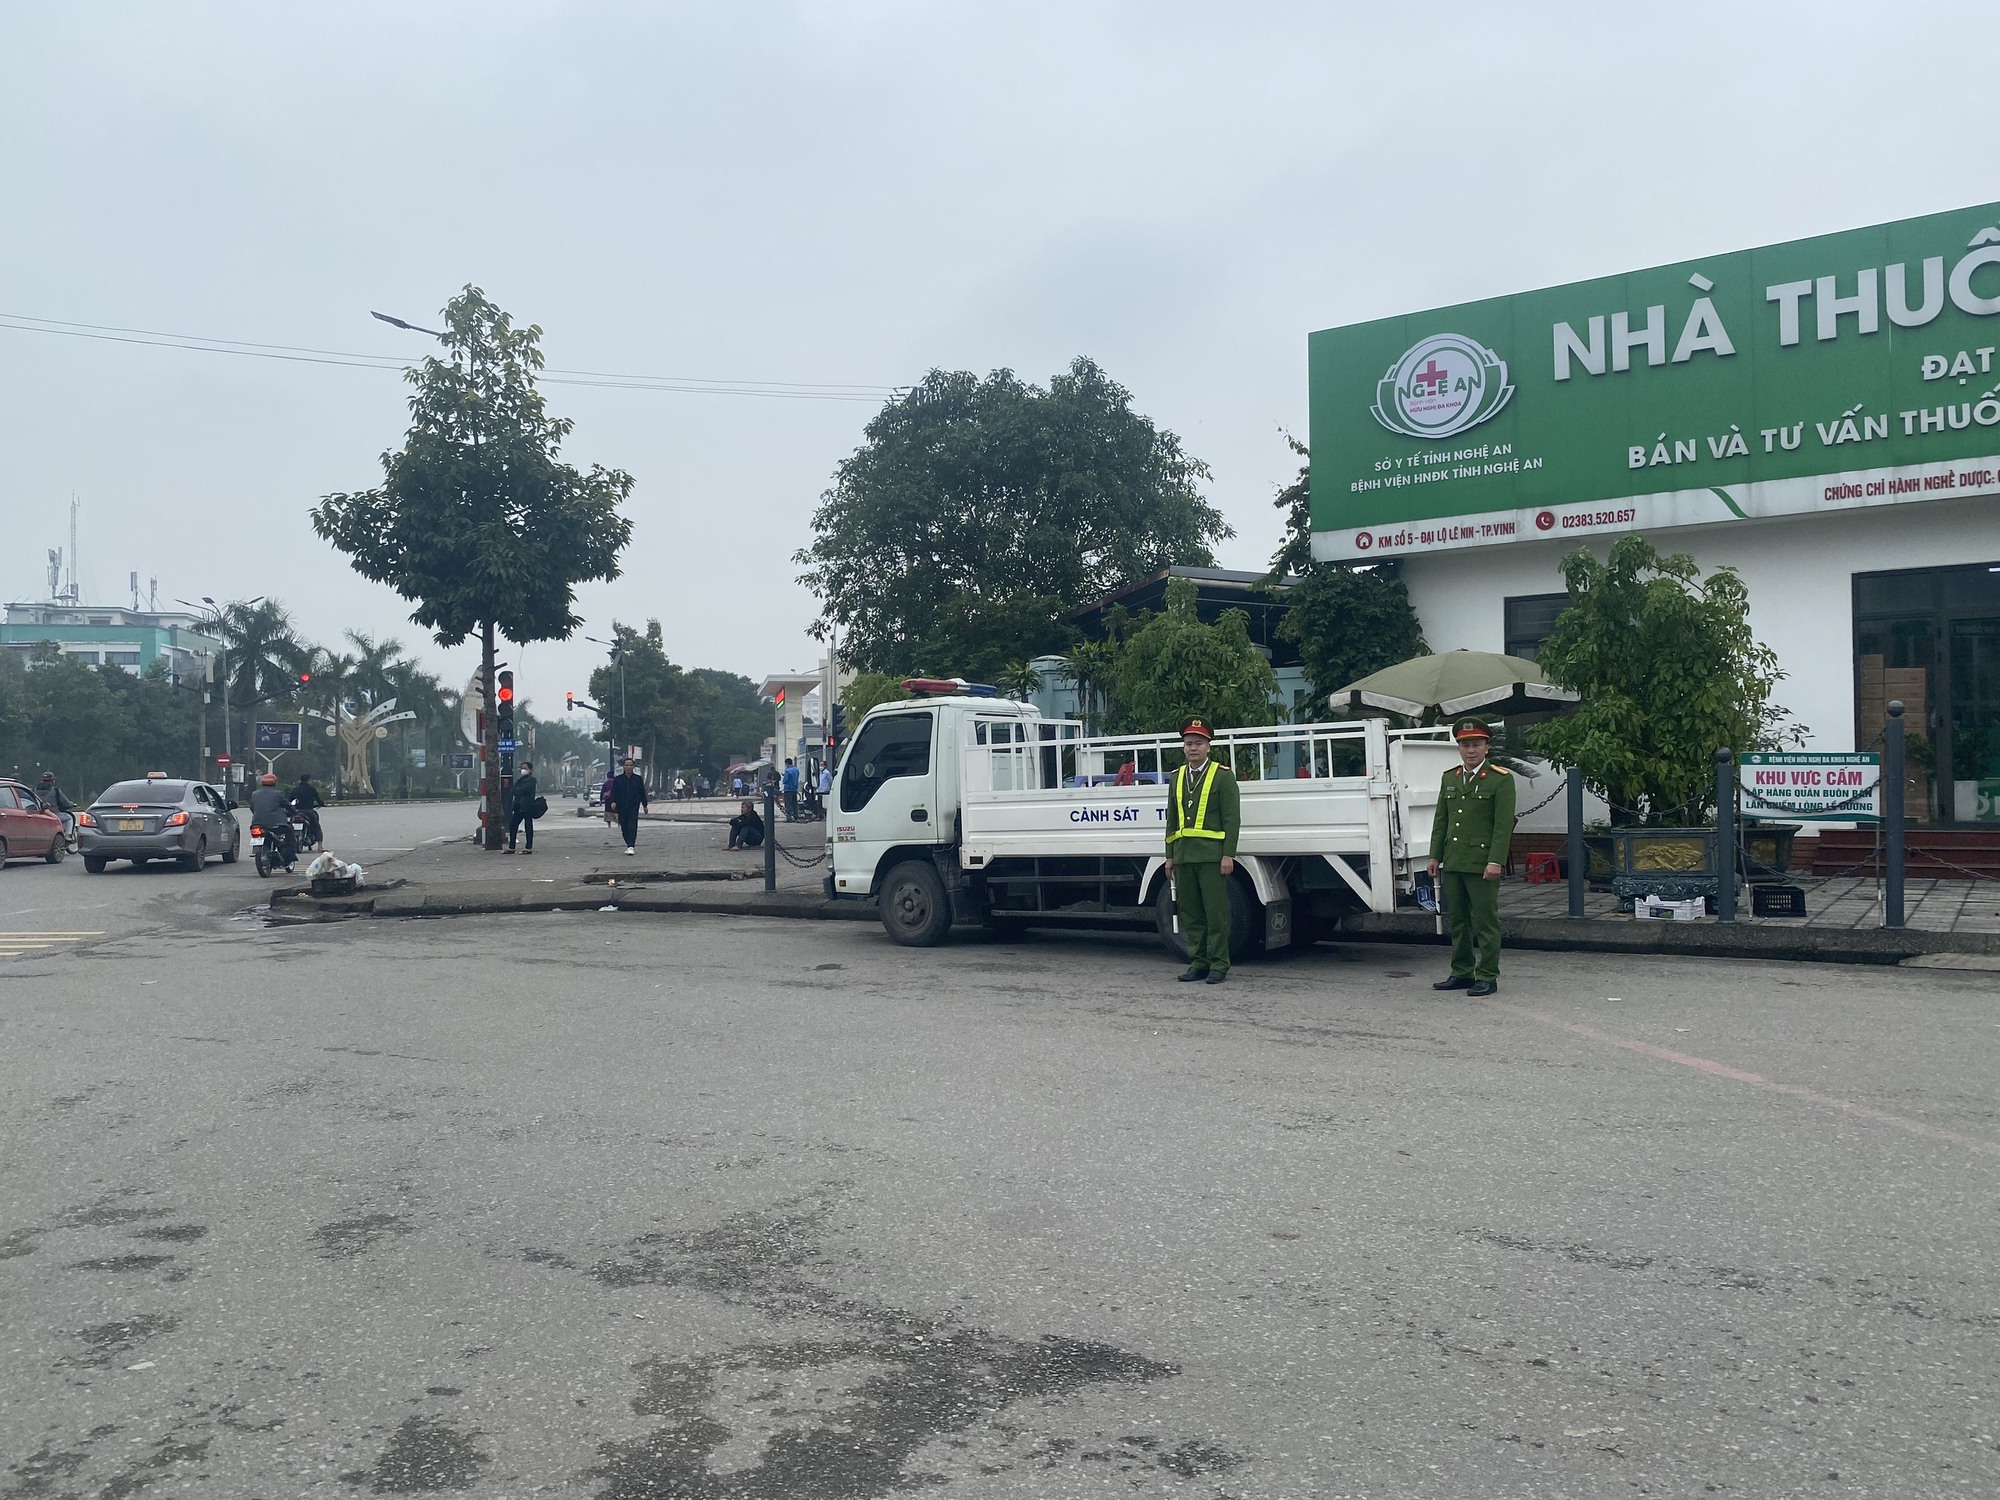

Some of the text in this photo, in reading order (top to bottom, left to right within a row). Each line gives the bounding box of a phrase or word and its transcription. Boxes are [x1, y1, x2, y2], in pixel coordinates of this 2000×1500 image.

[1553, 272, 1736, 381] NHÀ
[1921, 347, 1995, 385] ĐẠT
[1628, 432, 1696, 469] BÁN
[1707, 424, 1749, 459] VÀ
[1761, 421, 1803, 452] TƯ
[1816, 403, 1888, 445] VẤN
[1374, 444, 1512, 471] SỞ Y TẾ TỈNH NGHỆ AN
[1351, 458, 1543, 493] BỆNH VIỆN HNĐK TỈNH NGHỆ AN
[1824, 482, 1862, 501] CHỨNG
[1866, 479, 1885, 496] CHỈ
[1889, 478, 1920, 494] HÀNH
[1924, 469, 1955, 490] NGHỀ
[1959, 470, 1995, 488] DƯỢC:
[1562, 509, 1636, 528] 02383.520.657
[1378, 535, 1392, 548] KM
[1394, 529, 1405, 546] SỐ
[1407, 533, 1413, 544] 5
[1420, 531, 1434, 545] ĐẠI
[1437, 527, 1447, 543] LỘ
[1449, 526, 1458, 540] LÊ
[1460, 526, 1474, 539] NIN
[1481, 522, 1515, 537] TP.VINH
[1755, 766, 1862, 788] KHU VỰC CẤM
[1766, 787, 1791, 797] HÀNG
[1794, 787, 1820, 797] QUÁN
[1823, 787, 1849, 797] BUÔN
[1070, 807, 1109, 822] CẢNH
[1113, 806, 1139, 821] SÁT
